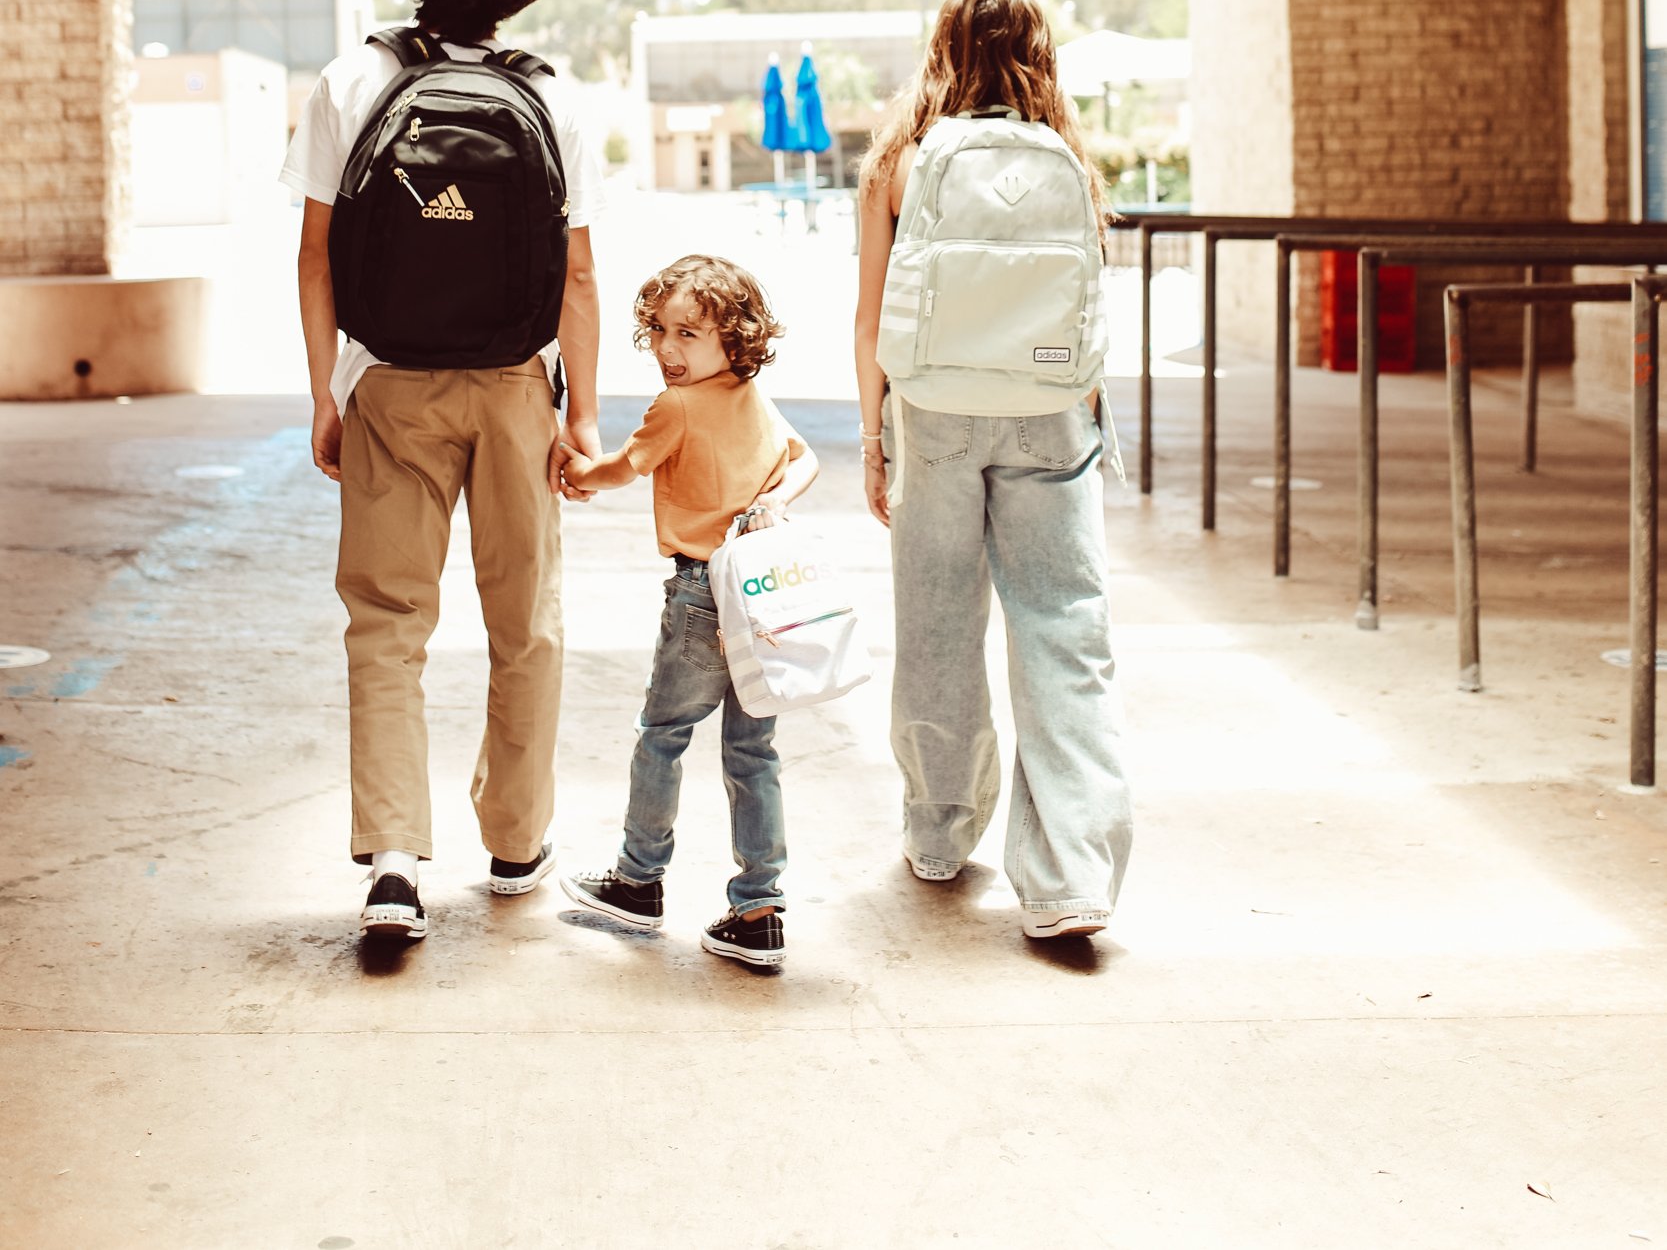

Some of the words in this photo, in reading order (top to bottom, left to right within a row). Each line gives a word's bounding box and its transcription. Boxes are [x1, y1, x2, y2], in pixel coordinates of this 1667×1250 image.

[421, 206, 474, 221] adidas
[1037, 351, 1067, 359] adidas
[743, 561, 832, 596] adidas
